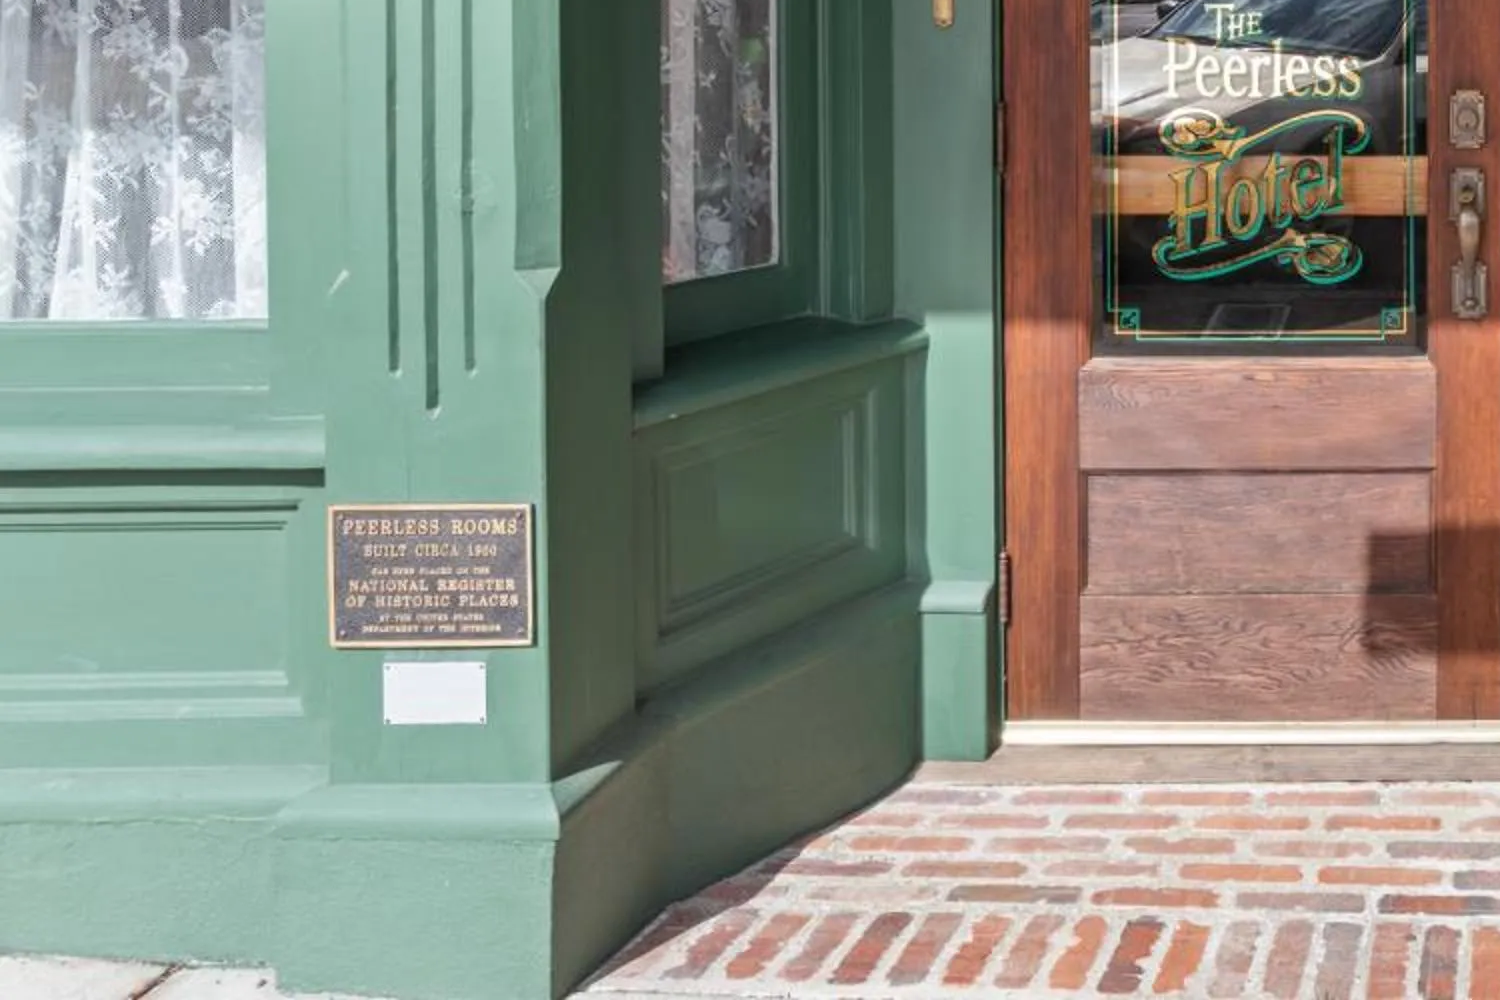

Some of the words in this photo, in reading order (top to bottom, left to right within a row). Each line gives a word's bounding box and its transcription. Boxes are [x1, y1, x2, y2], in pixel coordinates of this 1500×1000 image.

[1162, 37, 1362, 99] Peerless
[1168, 125, 1344, 259] Hotel
[342, 519, 440, 535] PEERLESS
[451, 518, 518, 535] ROOMS
[363, 543, 408, 558] BUILT
[415, 543, 459, 557] CIRCA
[348, 579, 429, 592] NATIONAL
[437, 578, 516, 591] REGISTER
[344, 595, 367, 608] OF
[375, 595, 451, 607] HISTORIC
[458, 594, 519, 608] PLACES
